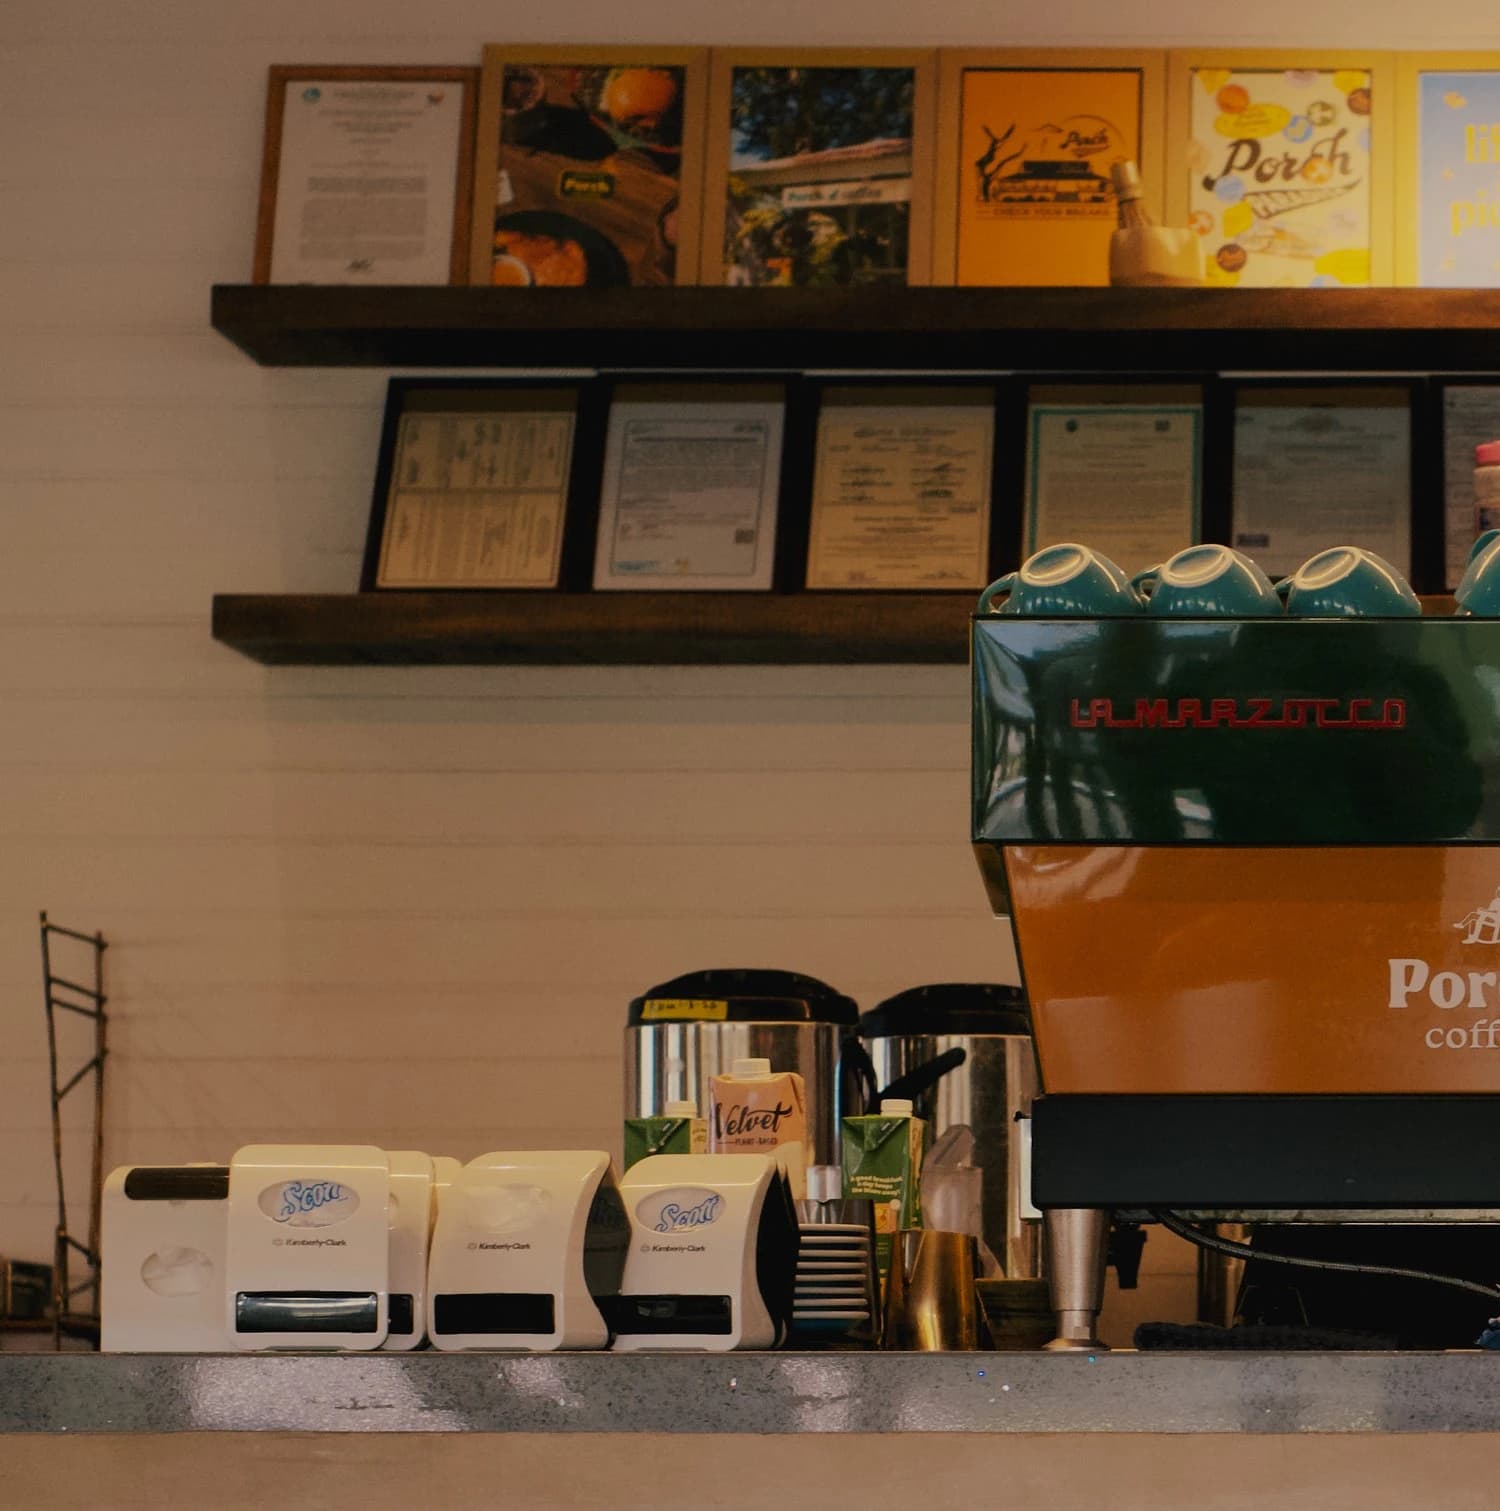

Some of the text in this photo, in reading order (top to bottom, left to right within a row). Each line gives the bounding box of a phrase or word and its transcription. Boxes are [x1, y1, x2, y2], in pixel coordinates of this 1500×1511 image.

[1071, 698, 1113, 728] LA
[715, 1100, 793, 1139] Velvet
[655, 1194, 720, 1233] Scott
